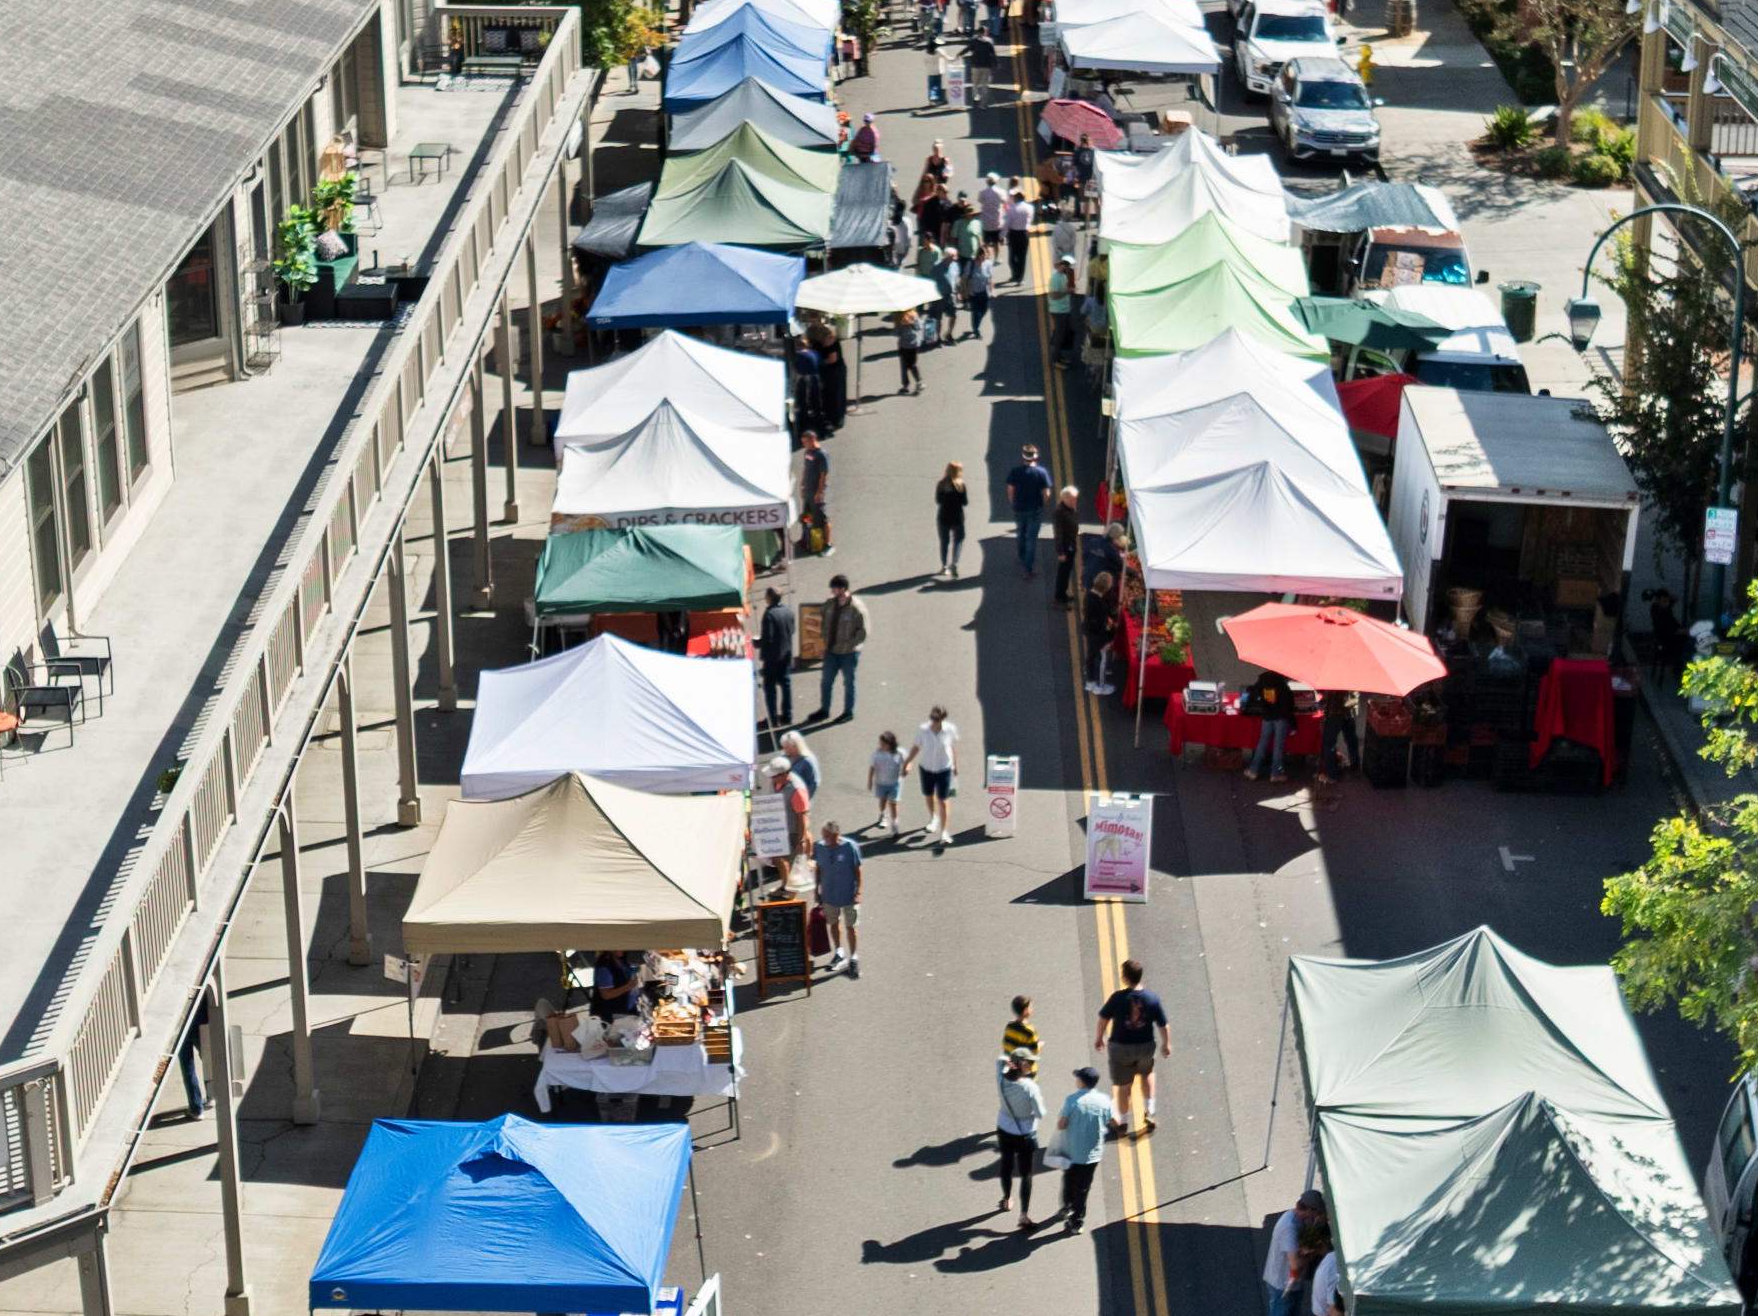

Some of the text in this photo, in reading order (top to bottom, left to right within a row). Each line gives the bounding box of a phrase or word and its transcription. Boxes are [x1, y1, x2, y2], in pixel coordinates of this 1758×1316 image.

[617, 508, 781, 528] DIPS & CRACKERS
